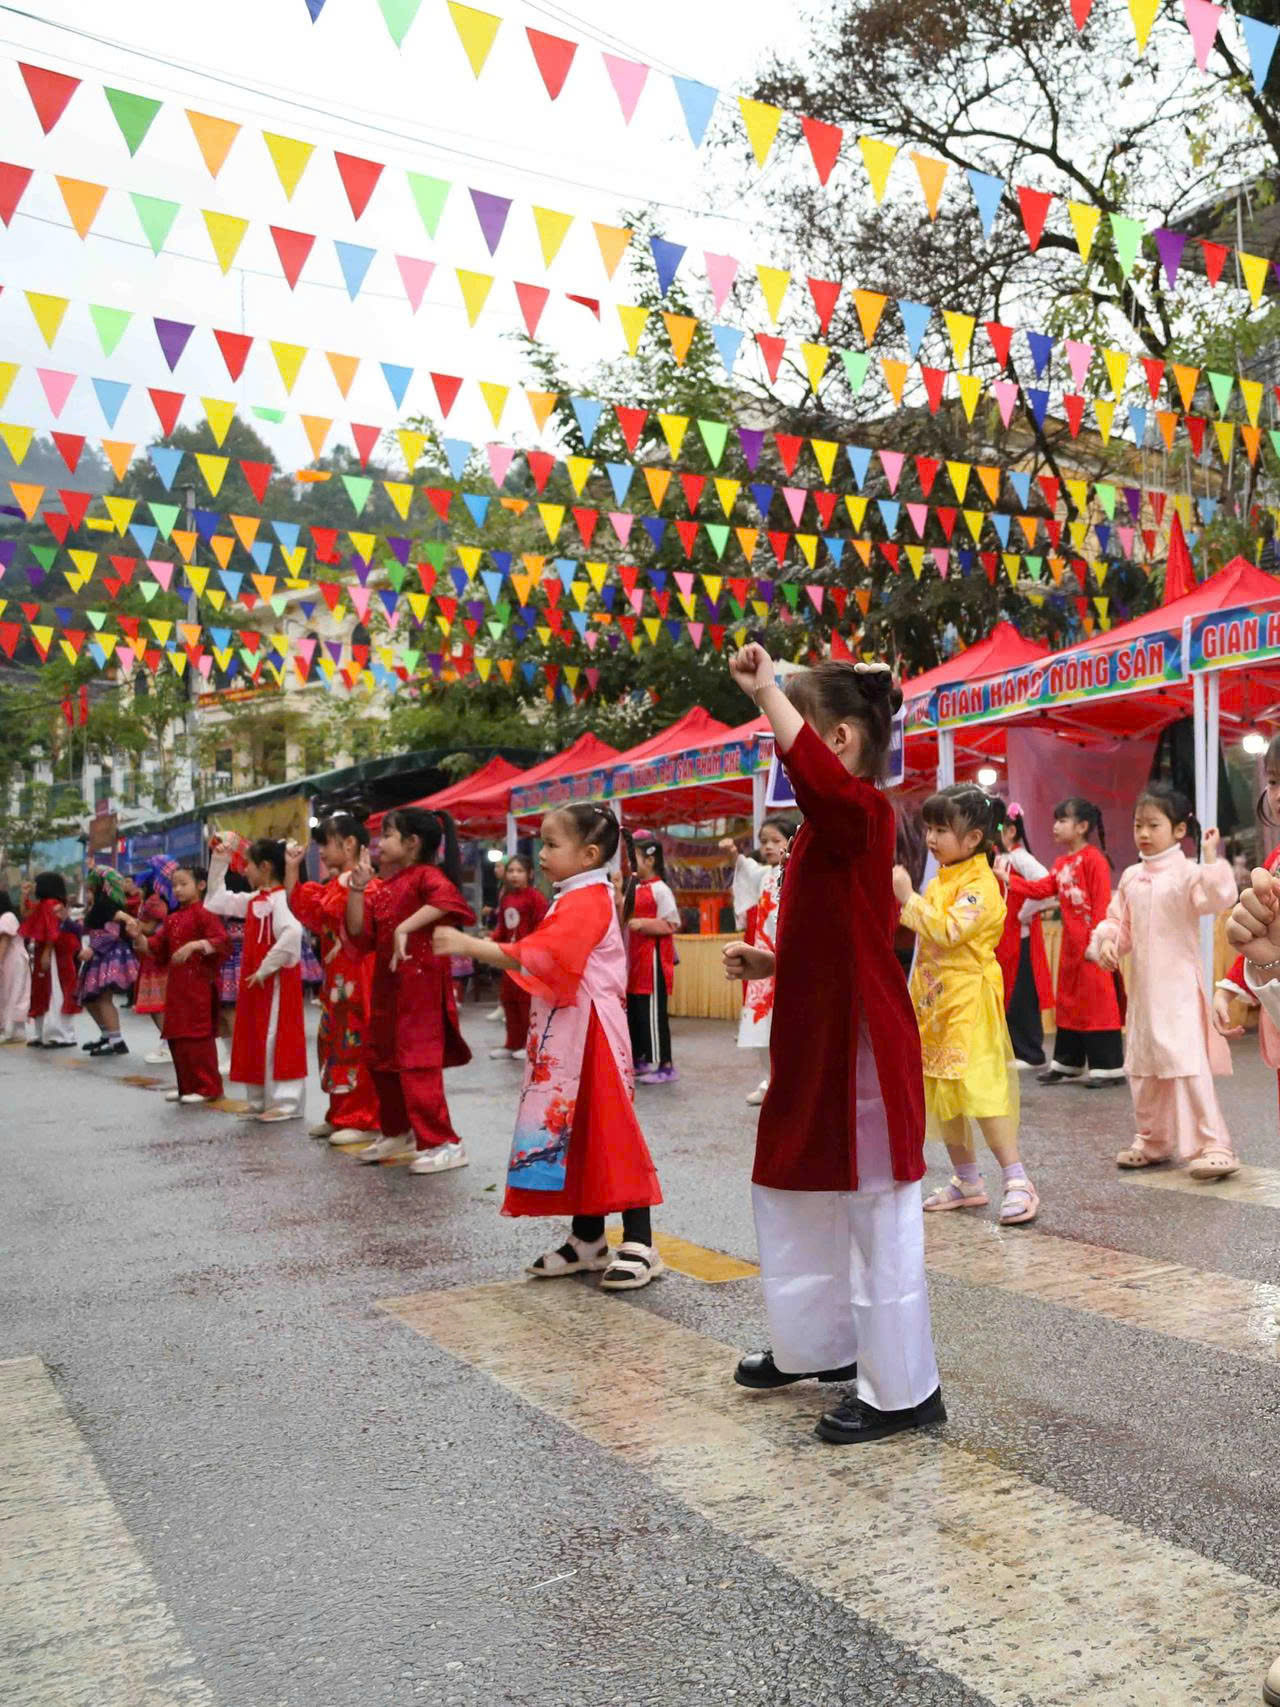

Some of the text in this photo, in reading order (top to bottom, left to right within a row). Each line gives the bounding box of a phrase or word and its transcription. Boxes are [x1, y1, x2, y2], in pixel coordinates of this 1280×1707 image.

[1202, 617, 1259, 660] GIAN
[938, 685, 984, 720] GIAN
[989, 670, 1044, 708] HÀNG
[1049, 655, 1110, 695] NÔNG
[1116, 637, 1165, 683] SẢN
